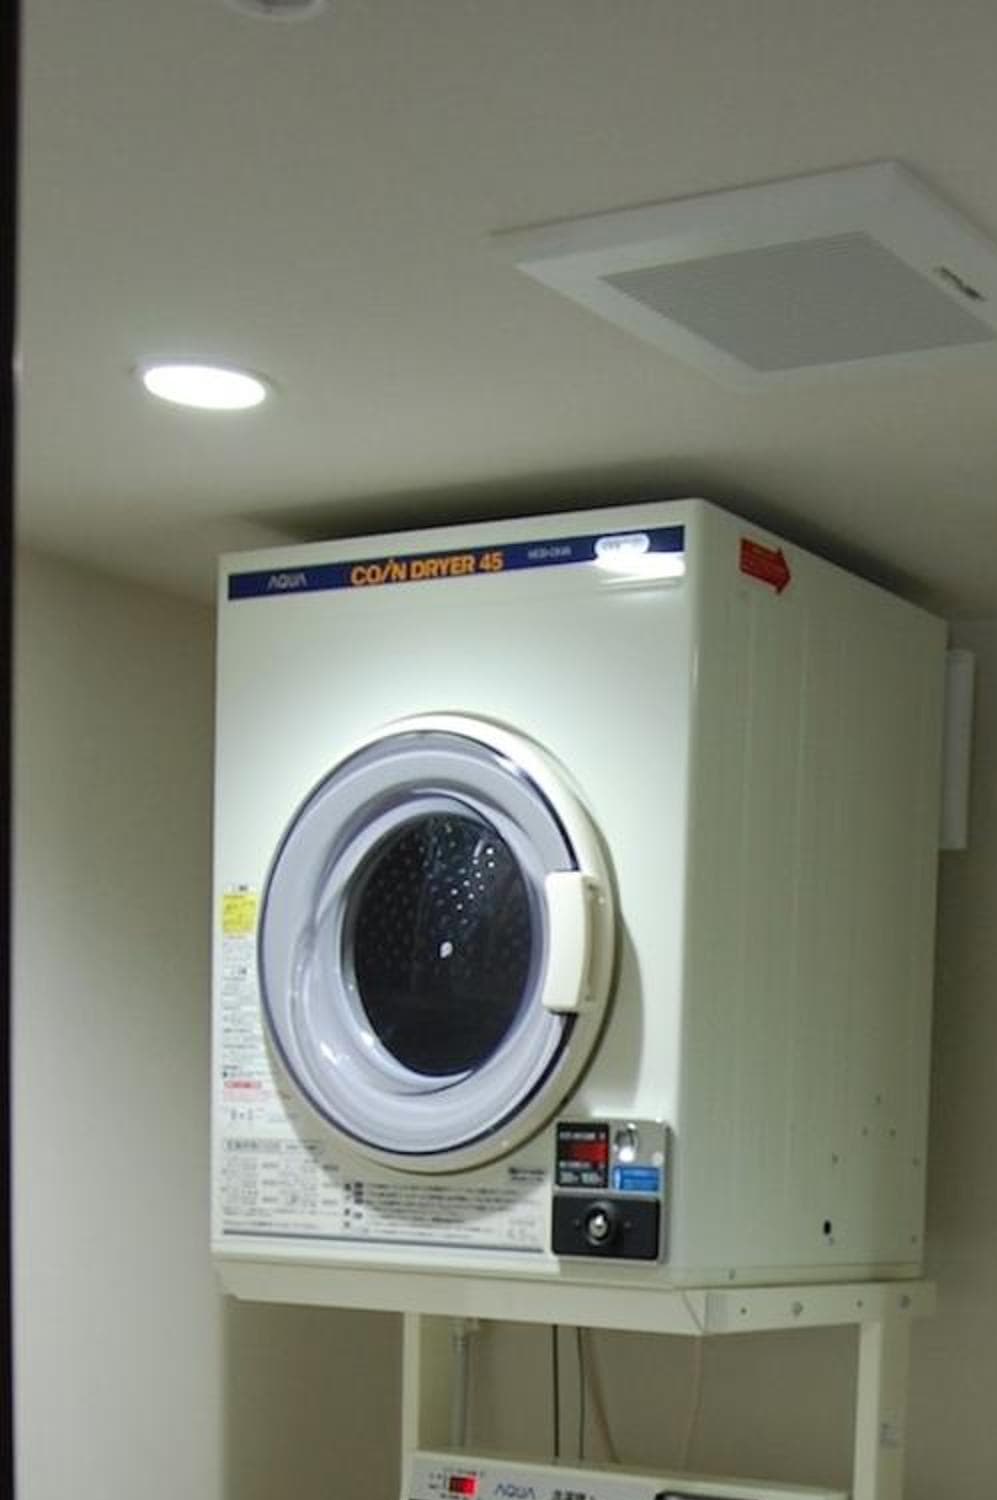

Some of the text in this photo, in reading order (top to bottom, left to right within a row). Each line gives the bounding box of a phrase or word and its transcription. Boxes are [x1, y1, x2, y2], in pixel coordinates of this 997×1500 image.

[409, 556, 475, 583] DRYER
[478, 551, 504, 573] 45
[266, 573, 308, 591] AQUA
